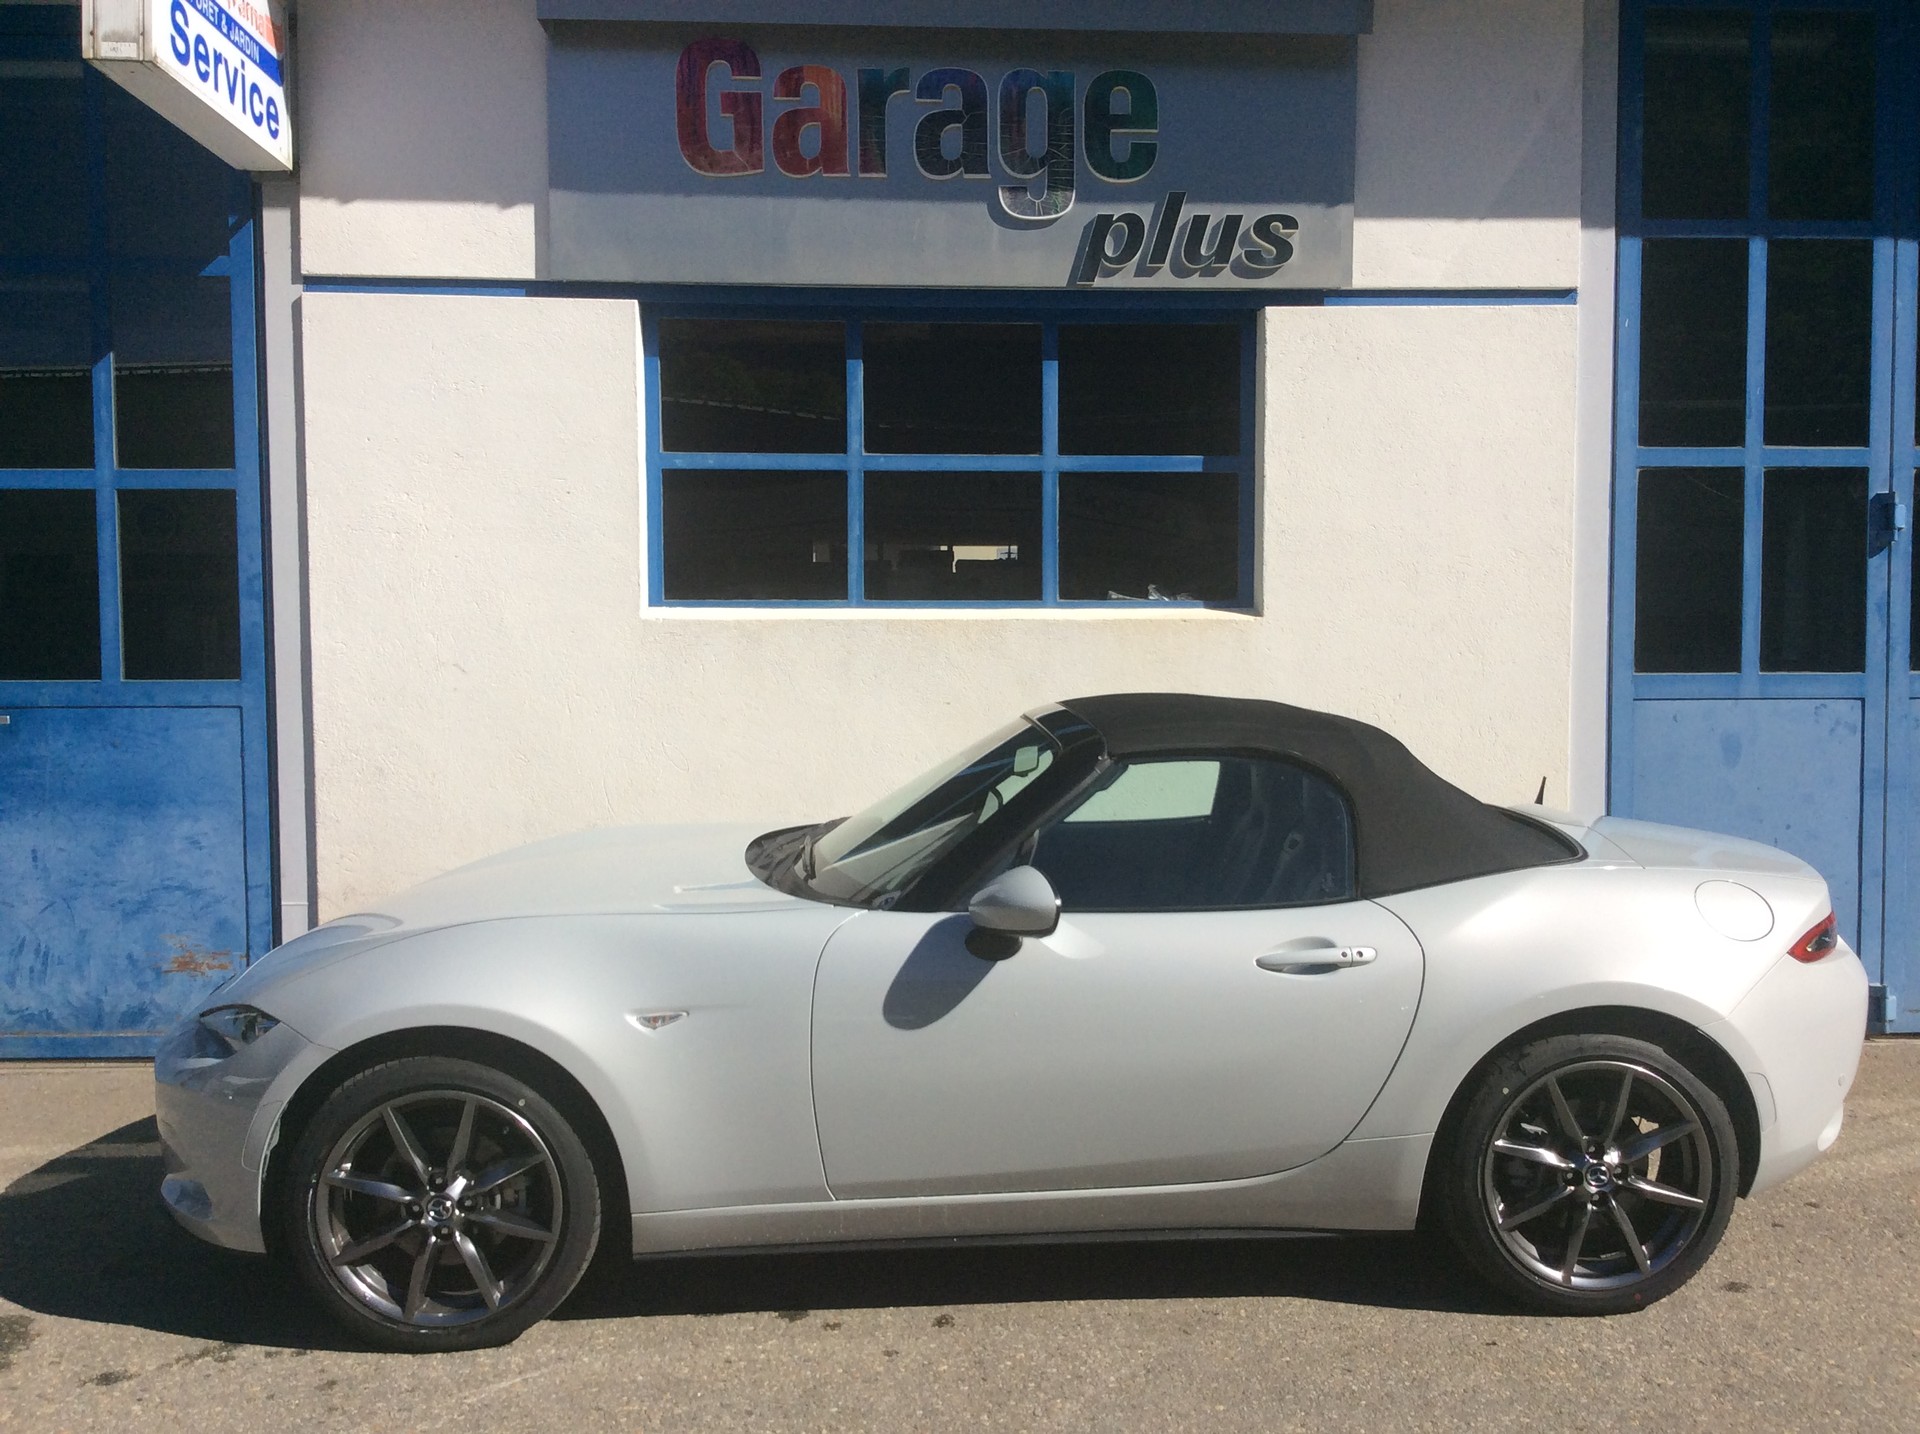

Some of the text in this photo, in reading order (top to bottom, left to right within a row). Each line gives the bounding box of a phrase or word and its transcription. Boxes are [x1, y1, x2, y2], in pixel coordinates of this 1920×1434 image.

[170, 0, 280, 140] Service
[189, 0, 260, 64] ORET & JARDIN
[675, 37, 1159, 220] Garage
[1077, 191, 1300, 285] plus
